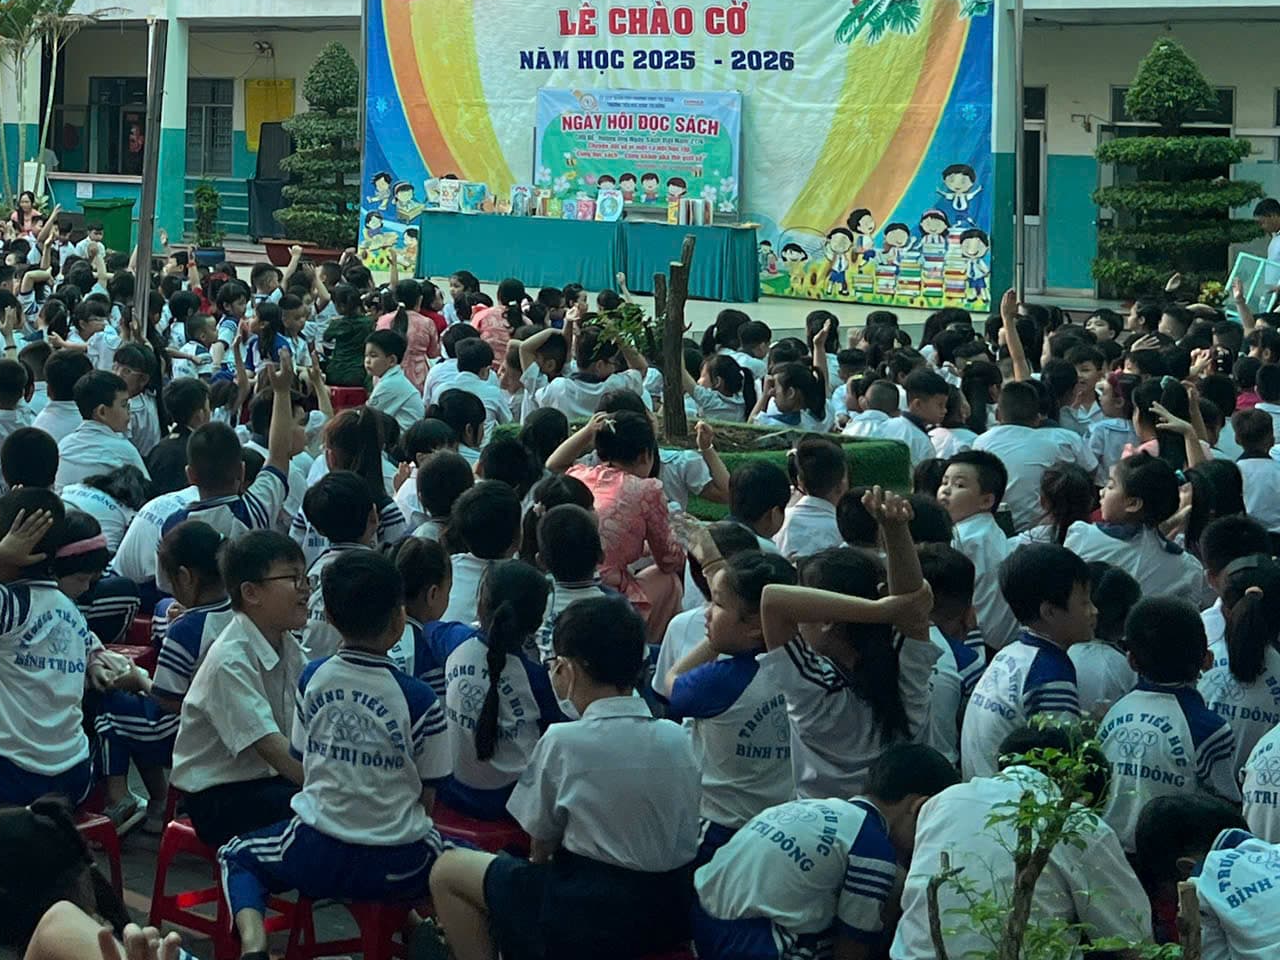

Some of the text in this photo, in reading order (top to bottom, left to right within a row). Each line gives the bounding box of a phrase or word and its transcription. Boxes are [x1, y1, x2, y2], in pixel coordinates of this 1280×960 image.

[608, 0, 694, 35] CHÀO
[520, 46, 570, 70] NĂM
[577, 50, 624, 74] HỌC
[632, 50, 696, 70] 2025
[731, 50, 794, 71] 2026
[562, 112, 720, 136] NGÀY HỘI ĐỌC SÁCH
[738, 693, 786, 738] TRƯỜNG
[1140, 713, 1173, 734] TIỂU
[736, 742, 772, 759] BÌNH
[1140, 764, 1185, 788] ĐÔNG
[1255, 790, 1278, 808] TRỊ
[770, 830, 816, 872] ĐÔNG
[1226, 878, 1273, 908] BÌNH
